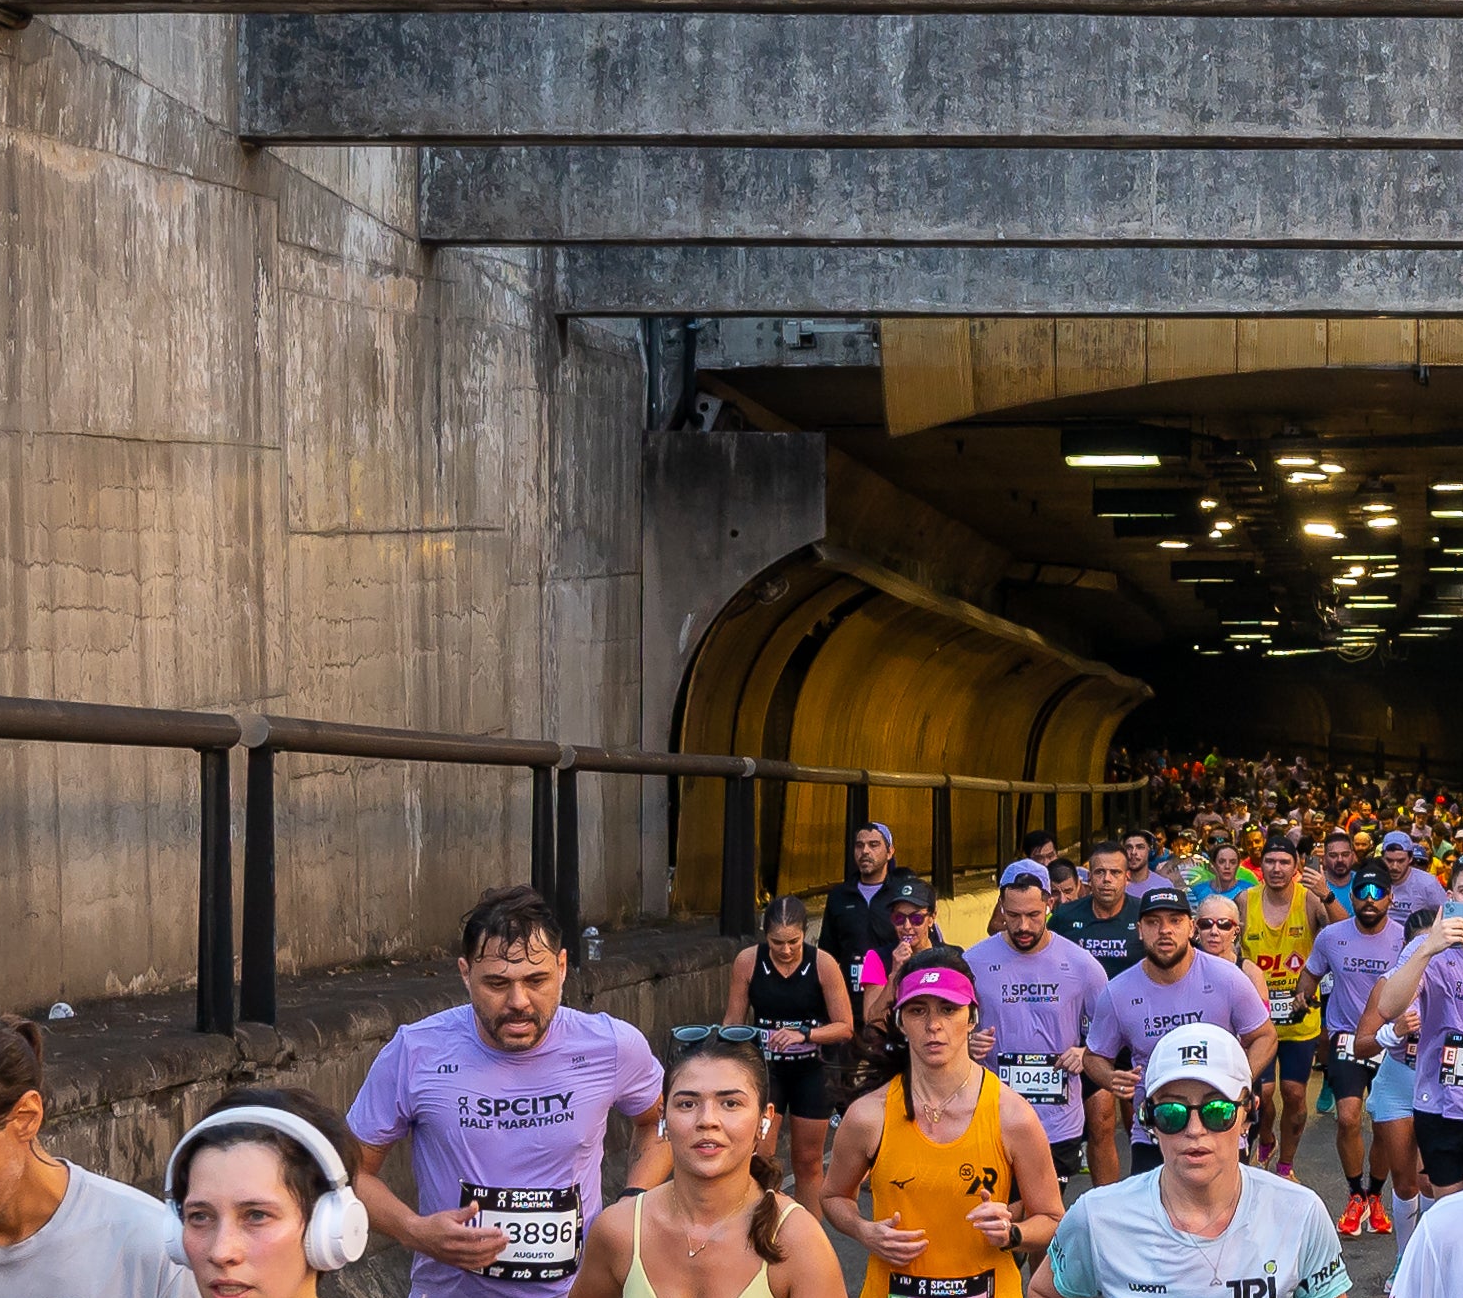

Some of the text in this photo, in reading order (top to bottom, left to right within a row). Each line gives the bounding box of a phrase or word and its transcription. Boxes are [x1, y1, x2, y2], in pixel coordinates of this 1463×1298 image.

[1086, 939, 1126, 949] SPCITY
[1350, 958, 1389, 969] SPCITY
[1012, 984, 1059, 995] SPCITY
[1154, 1011, 1203, 1028] SPCITY
[1001, 1069, 1008, 1079] D
[1015, 1072, 1060, 1084] 10438
[477, 1091, 575, 1117] SPCITY
[460, 1111, 574, 1130] HALF MARATHON
[512, 1191, 553, 1201] SPCITY
[494, 1221, 572, 1244] 3896
[931, 1280, 967, 1289] SPCITY
